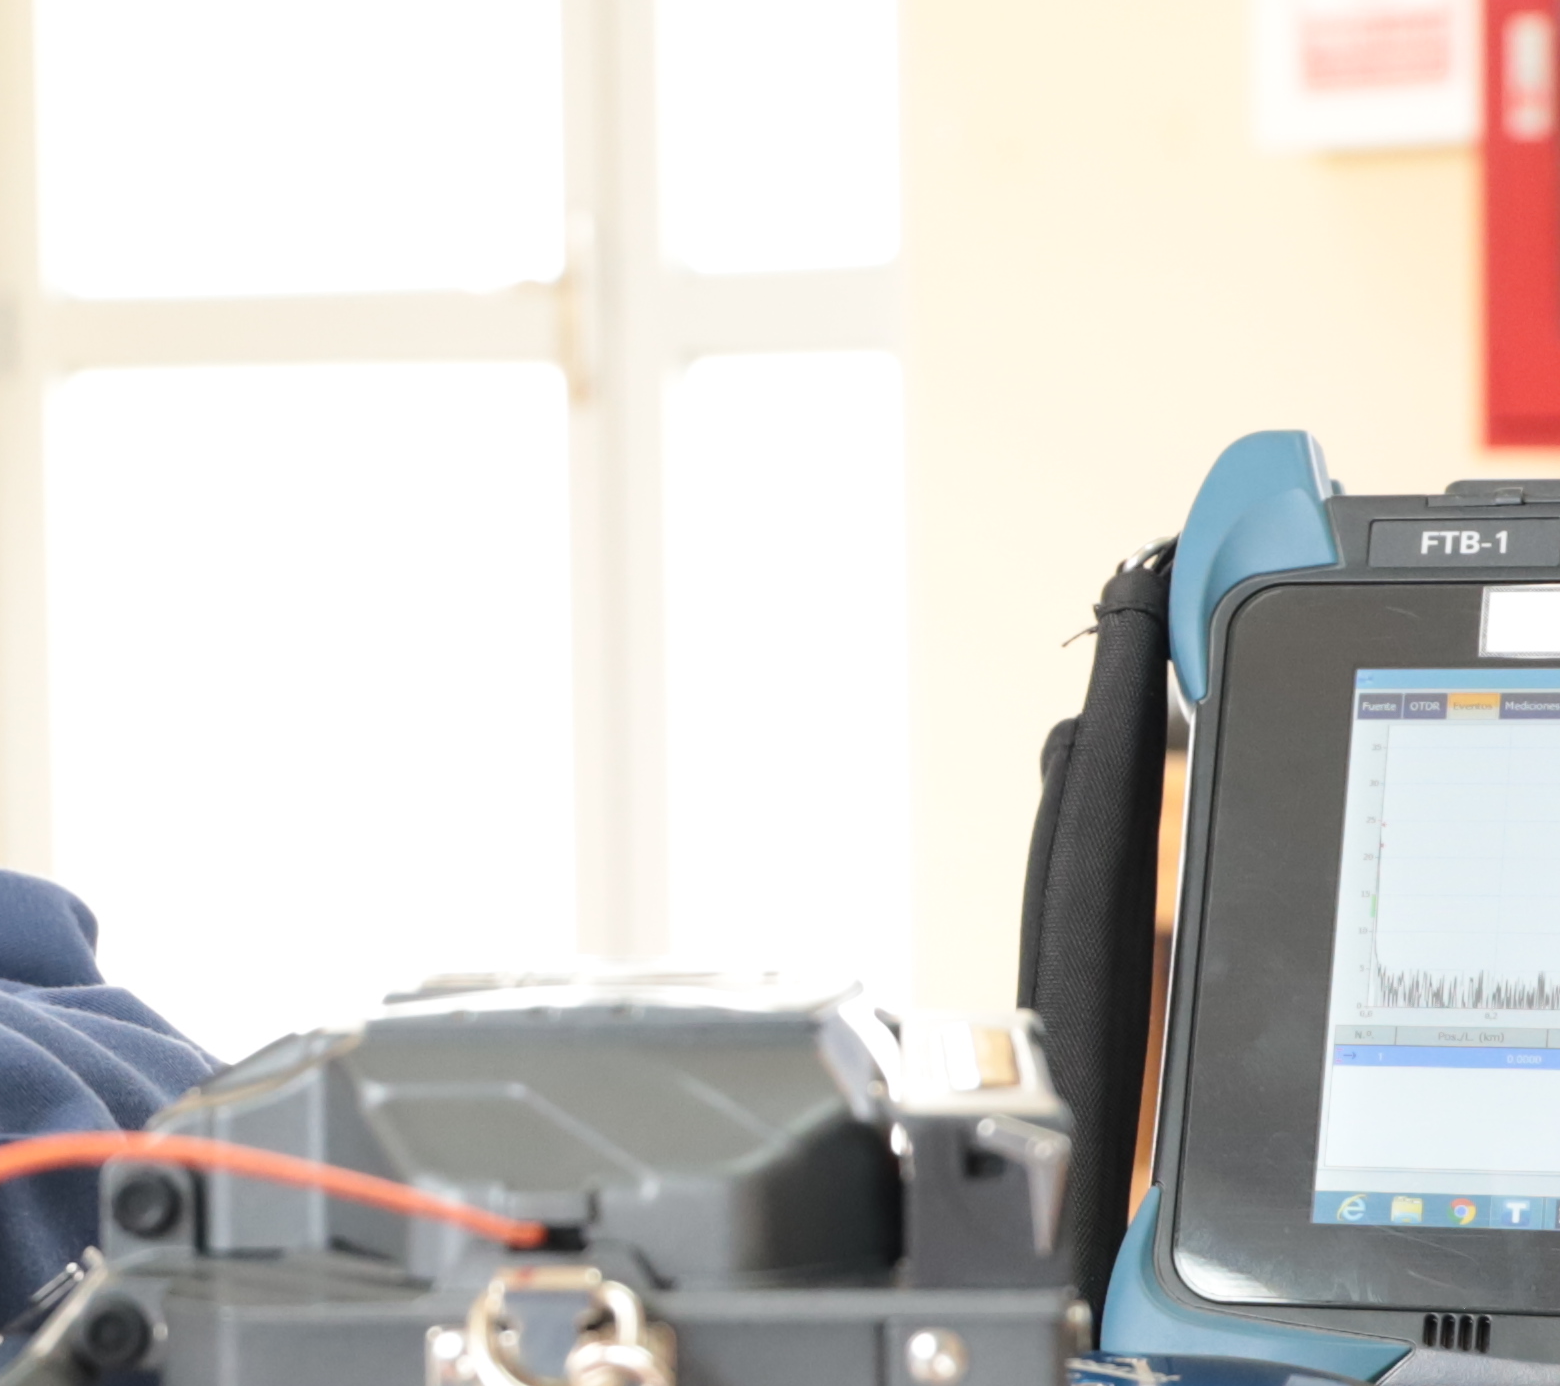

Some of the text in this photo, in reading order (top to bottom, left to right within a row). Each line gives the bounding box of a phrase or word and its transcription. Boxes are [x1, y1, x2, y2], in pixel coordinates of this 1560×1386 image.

[1420, 530, 1509, 555] FTB-1
[1362, 701, 1397, 712] Fuente
[1410, 701, 1440, 711] OTDR
[1452, 701, 1493, 711] Eventos
[1505, 700, 1560, 711] Mediciones
